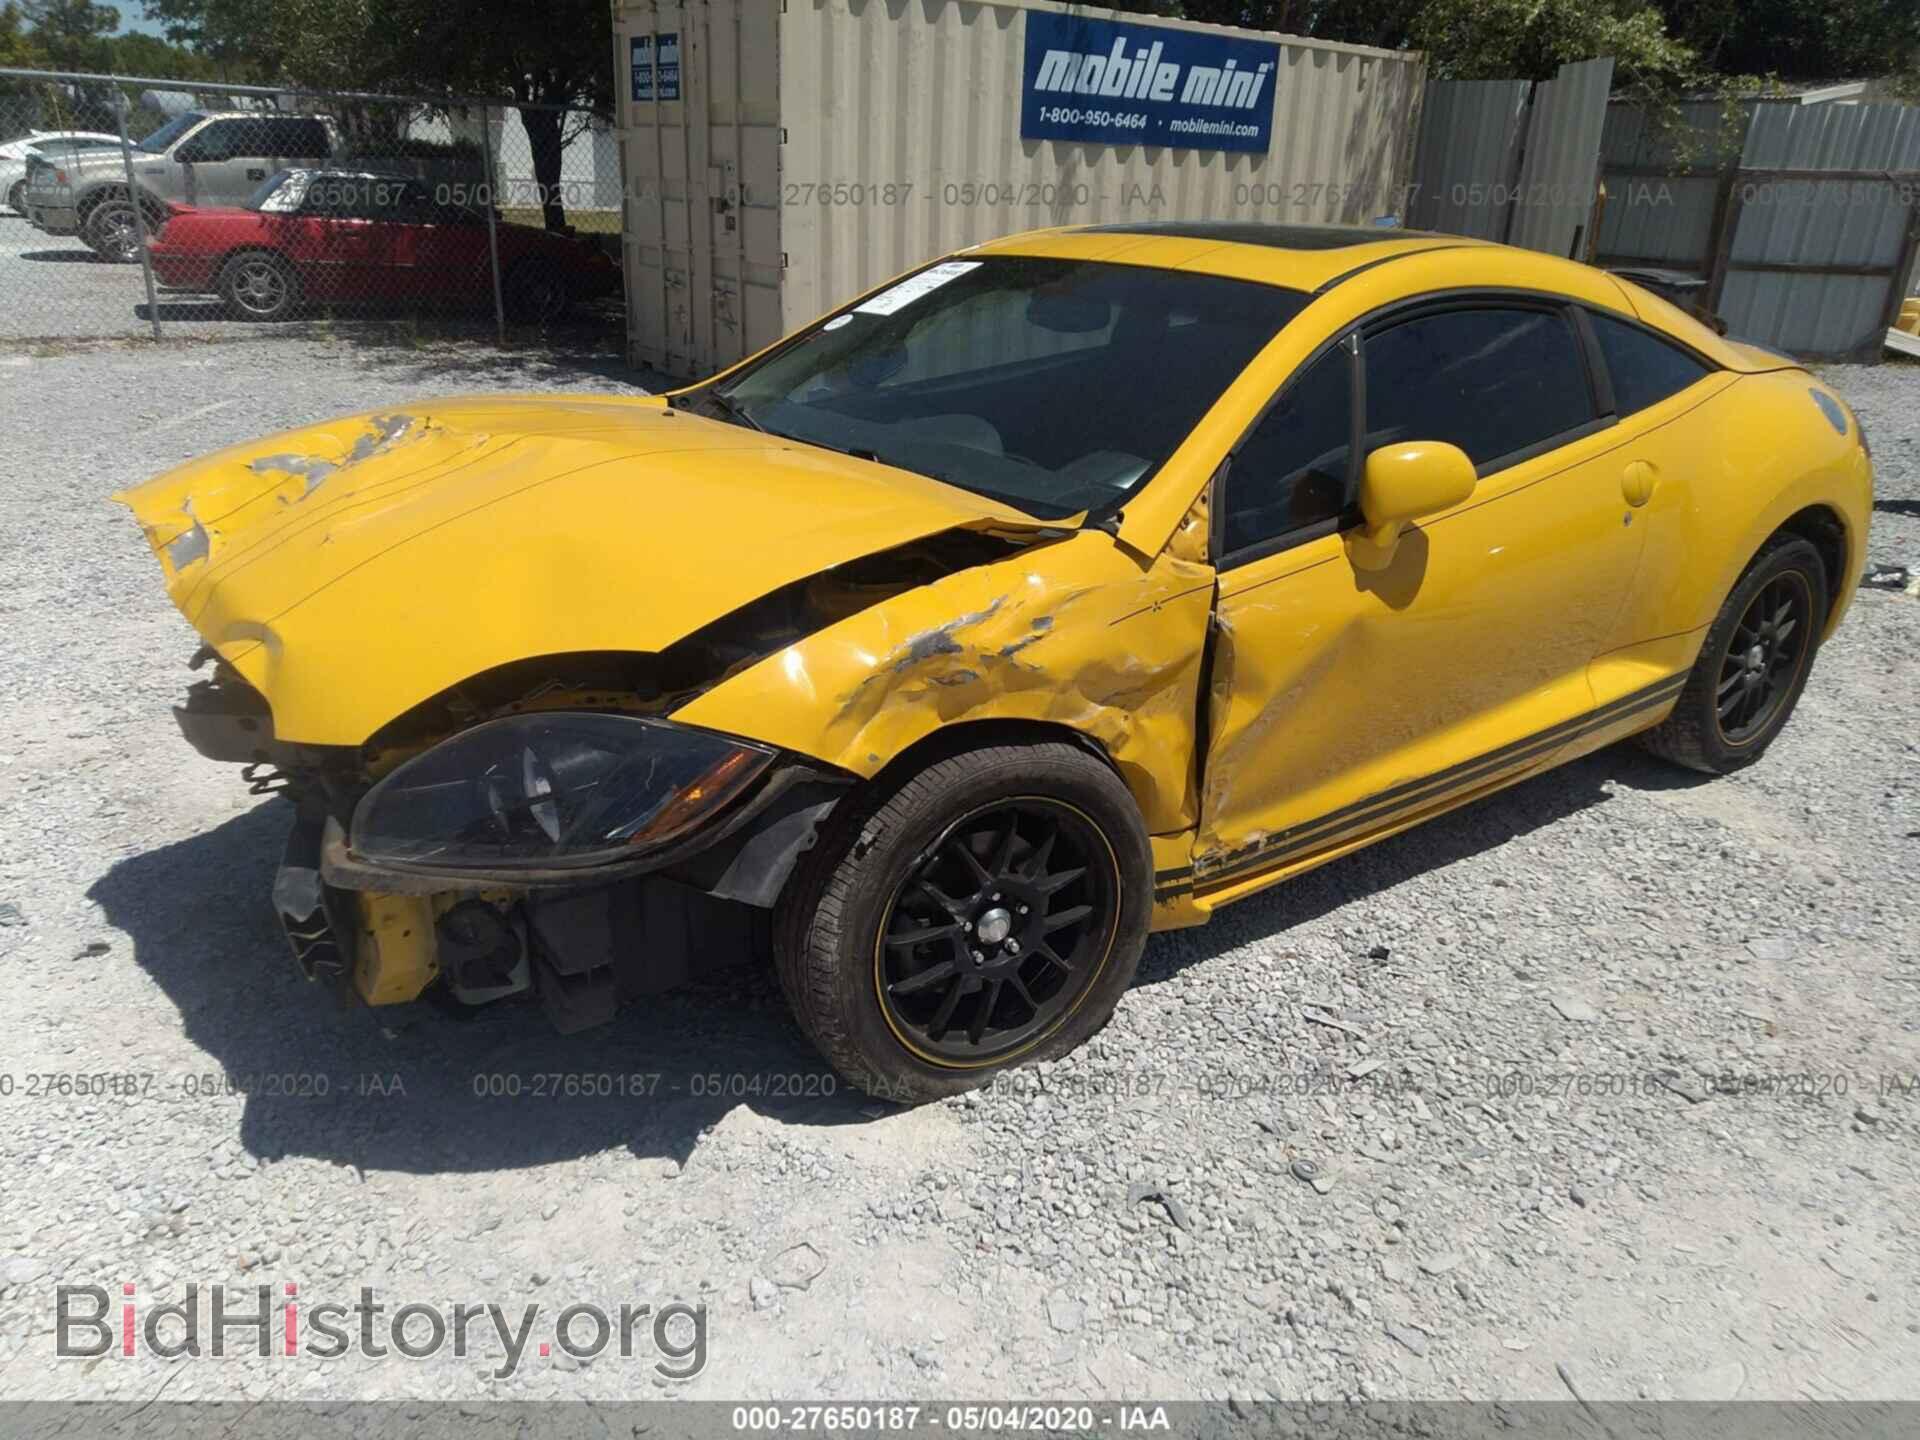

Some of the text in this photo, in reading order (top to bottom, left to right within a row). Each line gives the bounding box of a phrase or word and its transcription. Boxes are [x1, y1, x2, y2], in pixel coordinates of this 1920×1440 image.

[1034, 36, 1269, 109] mobile mini
[1038, 106, 1147, 129] 1-800-950-6464
[1169, 118, 1259, 137] mobilemini.com
